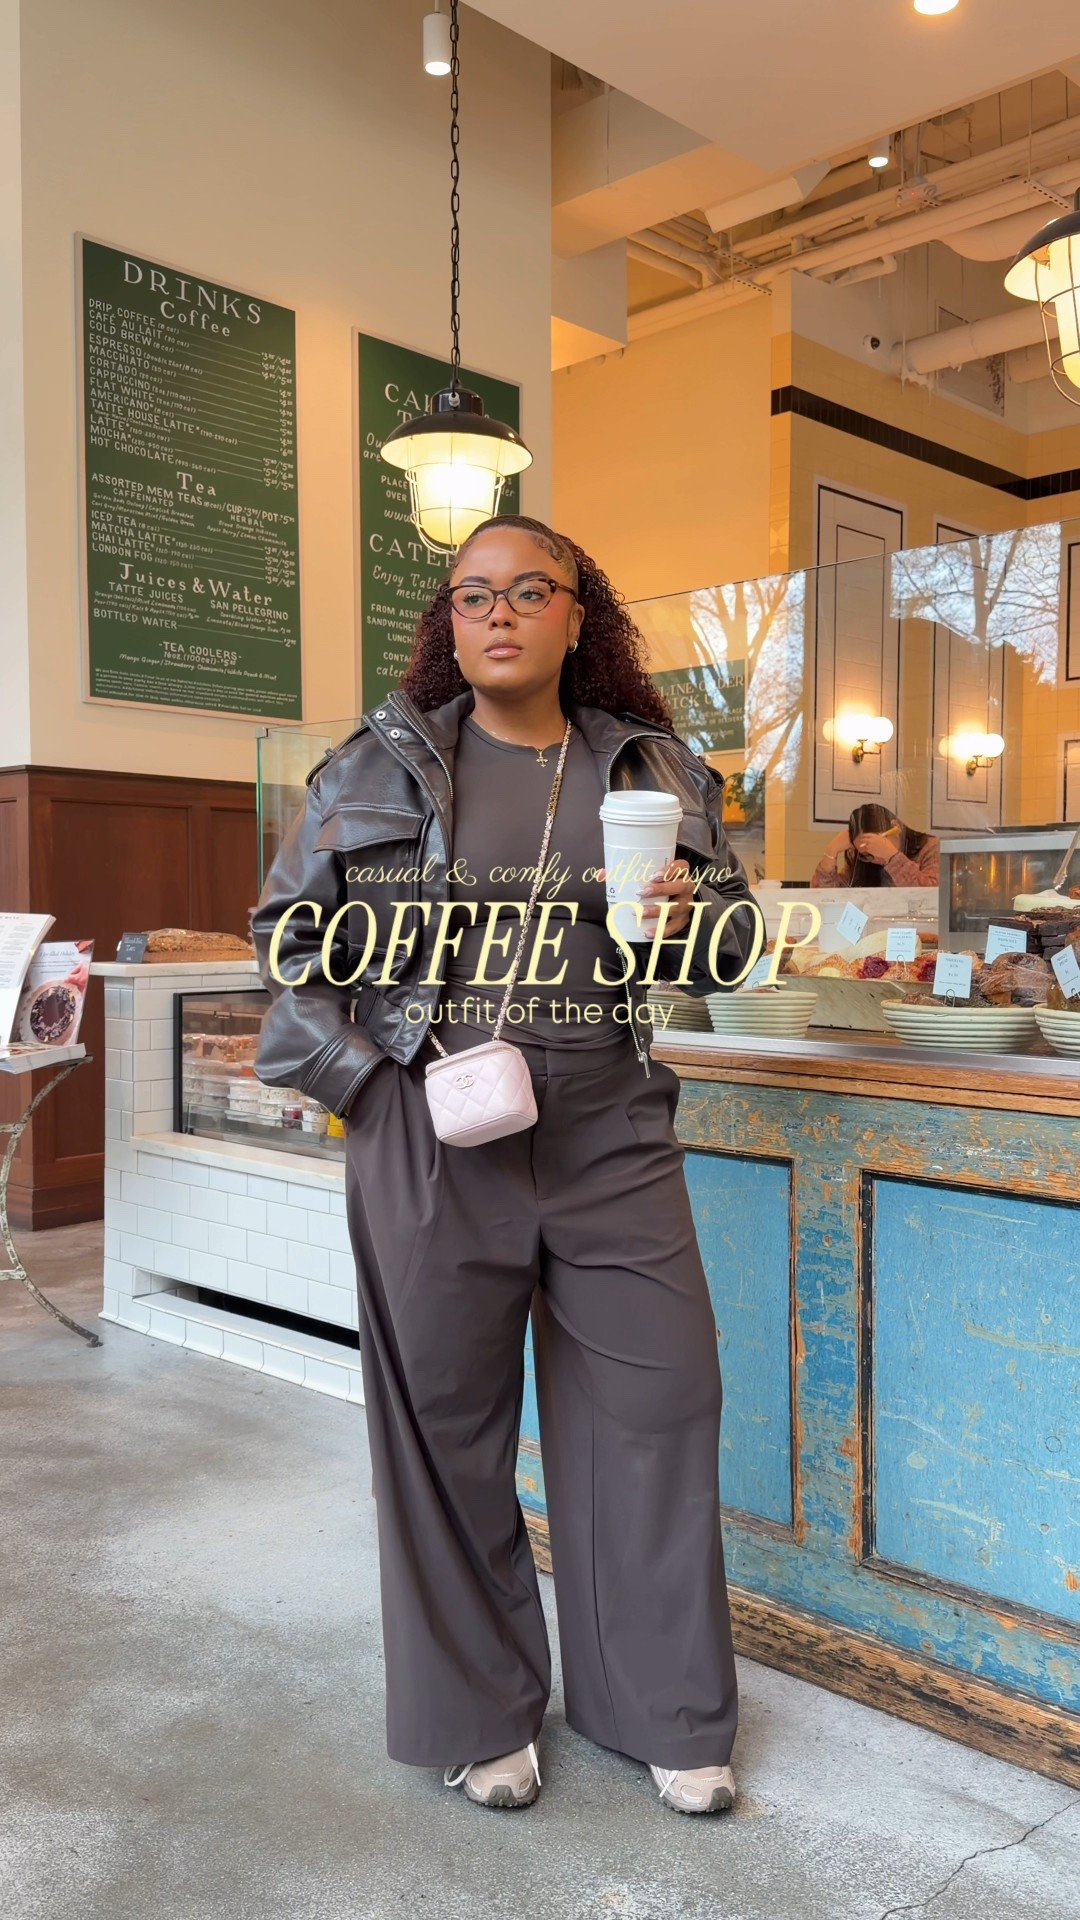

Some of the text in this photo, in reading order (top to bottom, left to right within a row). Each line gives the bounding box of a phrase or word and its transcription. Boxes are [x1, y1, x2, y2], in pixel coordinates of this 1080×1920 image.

[123, 260, 261, 325] DRINKS
[89, 298, 112, 313] DRIP
[117, 307, 156, 327] COFFEE
[89, 309, 116, 326] CAFÉ
[121, 319, 135, 331] AU
[140, 324, 163, 339] LAIT
[160, 301, 230, 337] Coffee
[89, 319, 116, 335] COLD
[120, 329, 152, 346] BREW
[89, 333, 142, 357] ESPRESSO
[89, 344, 150, 369] MACCHIATO
[89, 355, 138, 377] CORTADO
[89, 366, 151, 391] CAPPUCCINO
[90, 376, 116, 391] FLAT
[120, 384, 155, 403] WHITE
[90, 398, 124, 415] TATTE
[127, 408, 160, 425] HOUSE
[90, 435, 110, 448] HOT
[114, 441, 174, 464] CHOCOLATE
[91, 472, 144, 492] ASSORTED
[147, 485, 174, 499] MEM
[177, 491, 203, 506] TEAS
[176, 471, 216, 496] Tea
[381, 474, 408, 490] PLACE
[113, 487, 174, 507] CAFFEINATED
[385, 489, 407, 503] OVER
[91, 509, 113, 521] ICED
[117, 514, 137, 528] TEA
[91, 520, 135, 538] MATCHA
[230, 514, 264, 528] HERBAL
[91, 531, 115, 544] CHAI
[91, 542, 132, 558] LONDON
[134, 550, 153, 562] FOG
[119, 562, 272, 606] Juices & Water
[372, 565, 404, 587] Enjoy
[108, 581, 144, 597] TATTE
[148, 589, 184, 604] JUICES
[93, 607, 138, 623] BOTTLED
[142, 615, 178, 630] WATER
[210, 599, 229, 611] SAN
[232, 603, 289, 621] PELLEGRINO
[370, 603, 396, 615] FROM
